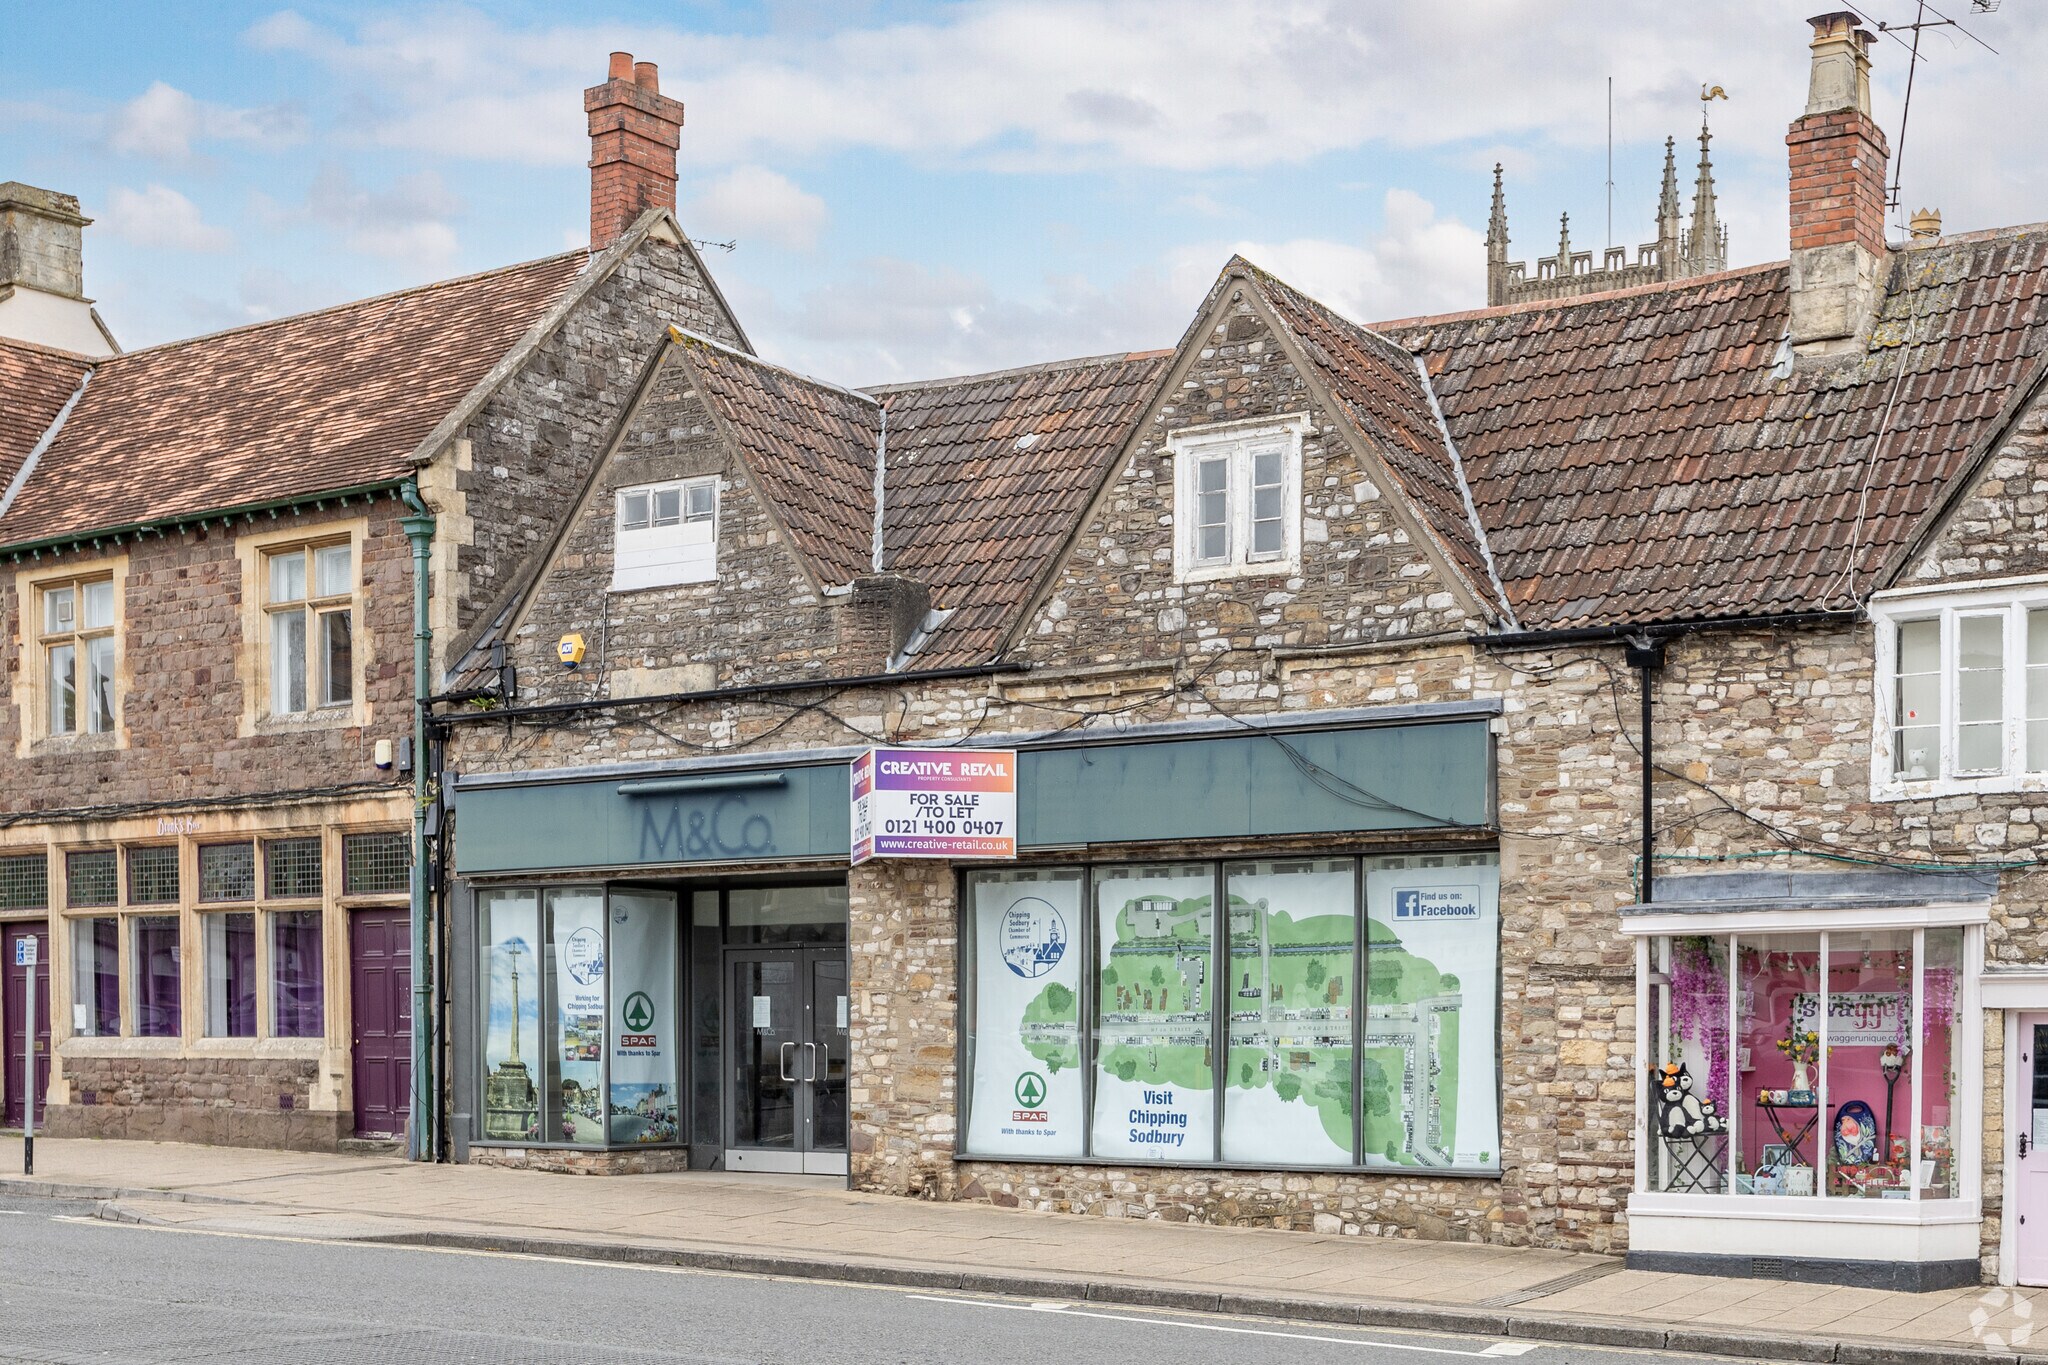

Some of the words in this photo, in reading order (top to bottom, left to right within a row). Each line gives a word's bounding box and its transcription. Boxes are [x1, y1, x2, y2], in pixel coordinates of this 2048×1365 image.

[880, 761, 952, 776] CREATIVE
[961, 763, 1008, 777] RETAIL
[910, 794, 939, 806] FOR
[945, 795, 979, 806] SALE
[915, 806, 944, 818] /TO
[949, 807, 975, 819] LET
[640, 793, 777, 860] M&Co.
[885, 820, 917, 834] 0121
[924, 821, 956, 834] 400
[963, 821, 1003, 835] 0407
[880, 839, 1008, 851] www.creative-retail.co.uk
[1420, 892, 1436, 901] Find
[1008, 911, 1030, 920] Chipping
[1421, 904, 1476, 916] Facebook
[567, 1002, 587, 1011] Chipping
[1803, 1001, 1895, 1029] swagge
[622, 1036, 656, 1046] SPAR
[1143, 1090, 1173, 1105] Visit
[1013, 1111, 1047, 1121] SPAR
[1129, 1109, 1187, 1128] Chipping
[1001, 1127, 1014, 1135] With
[1015, 1128, 1035, 1136] thanks
[1036, 1128, 1042, 1136] to
[1043, 1129, 1057, 1137] Spar
[1129, 1128, 1185, 1147] Sodbury
